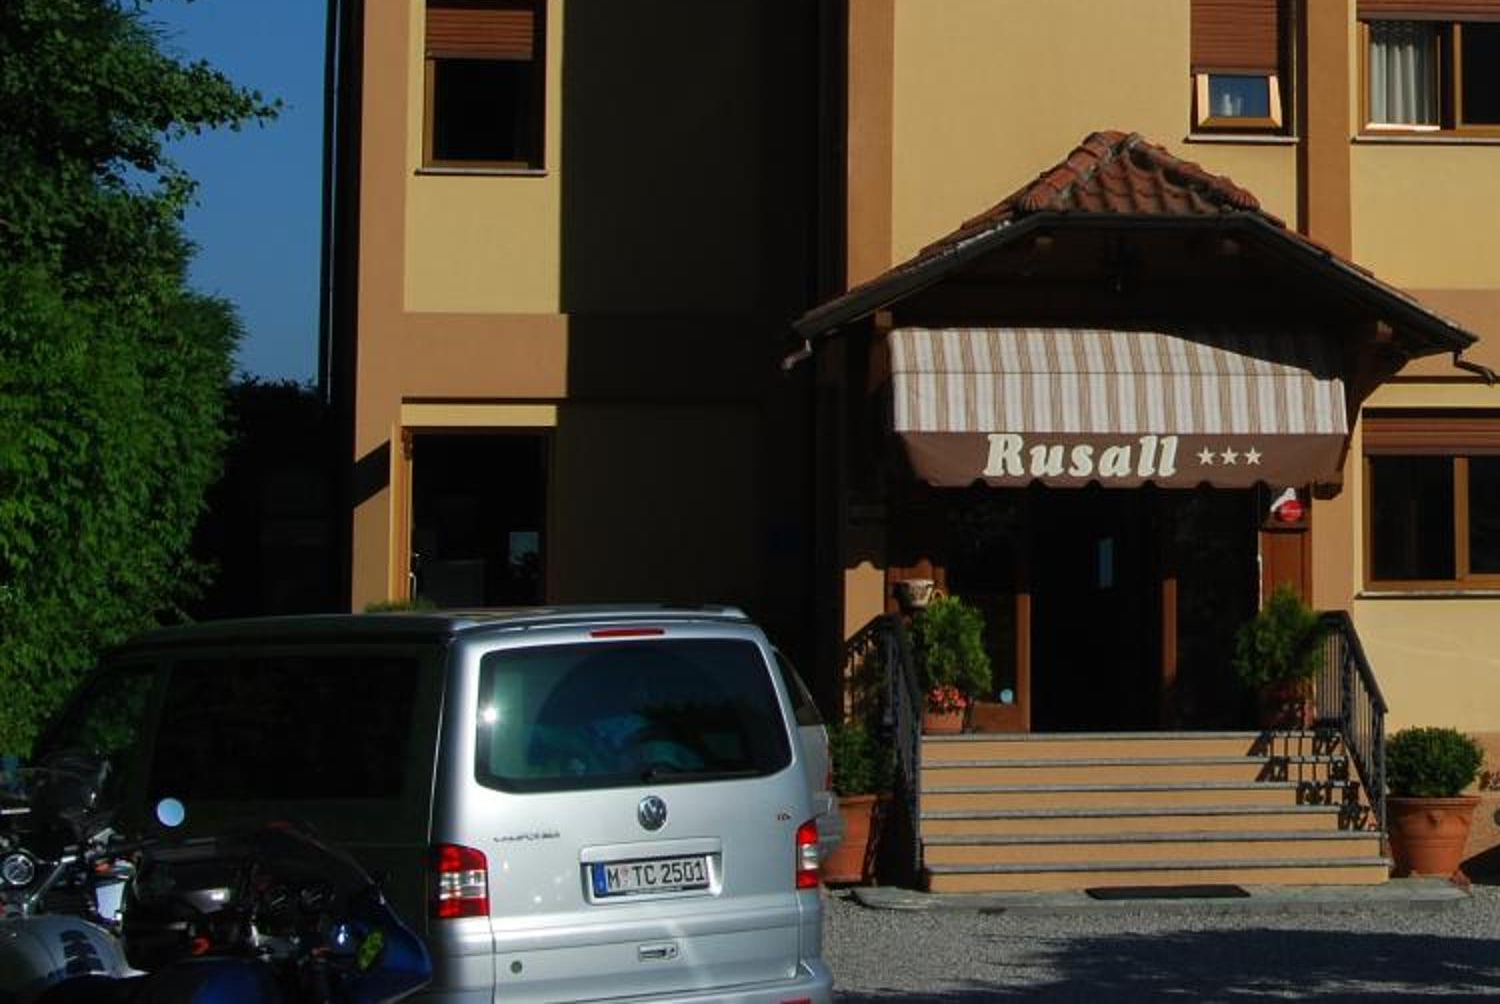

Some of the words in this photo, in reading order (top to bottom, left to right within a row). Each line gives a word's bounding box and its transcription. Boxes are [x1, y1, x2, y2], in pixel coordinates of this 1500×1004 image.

[983, 433, 1179, 477] Rusall
[607, 867, 621, 889] M
[632, 864, 657, 886] TC
[661, 860, 705, 884] 2501
